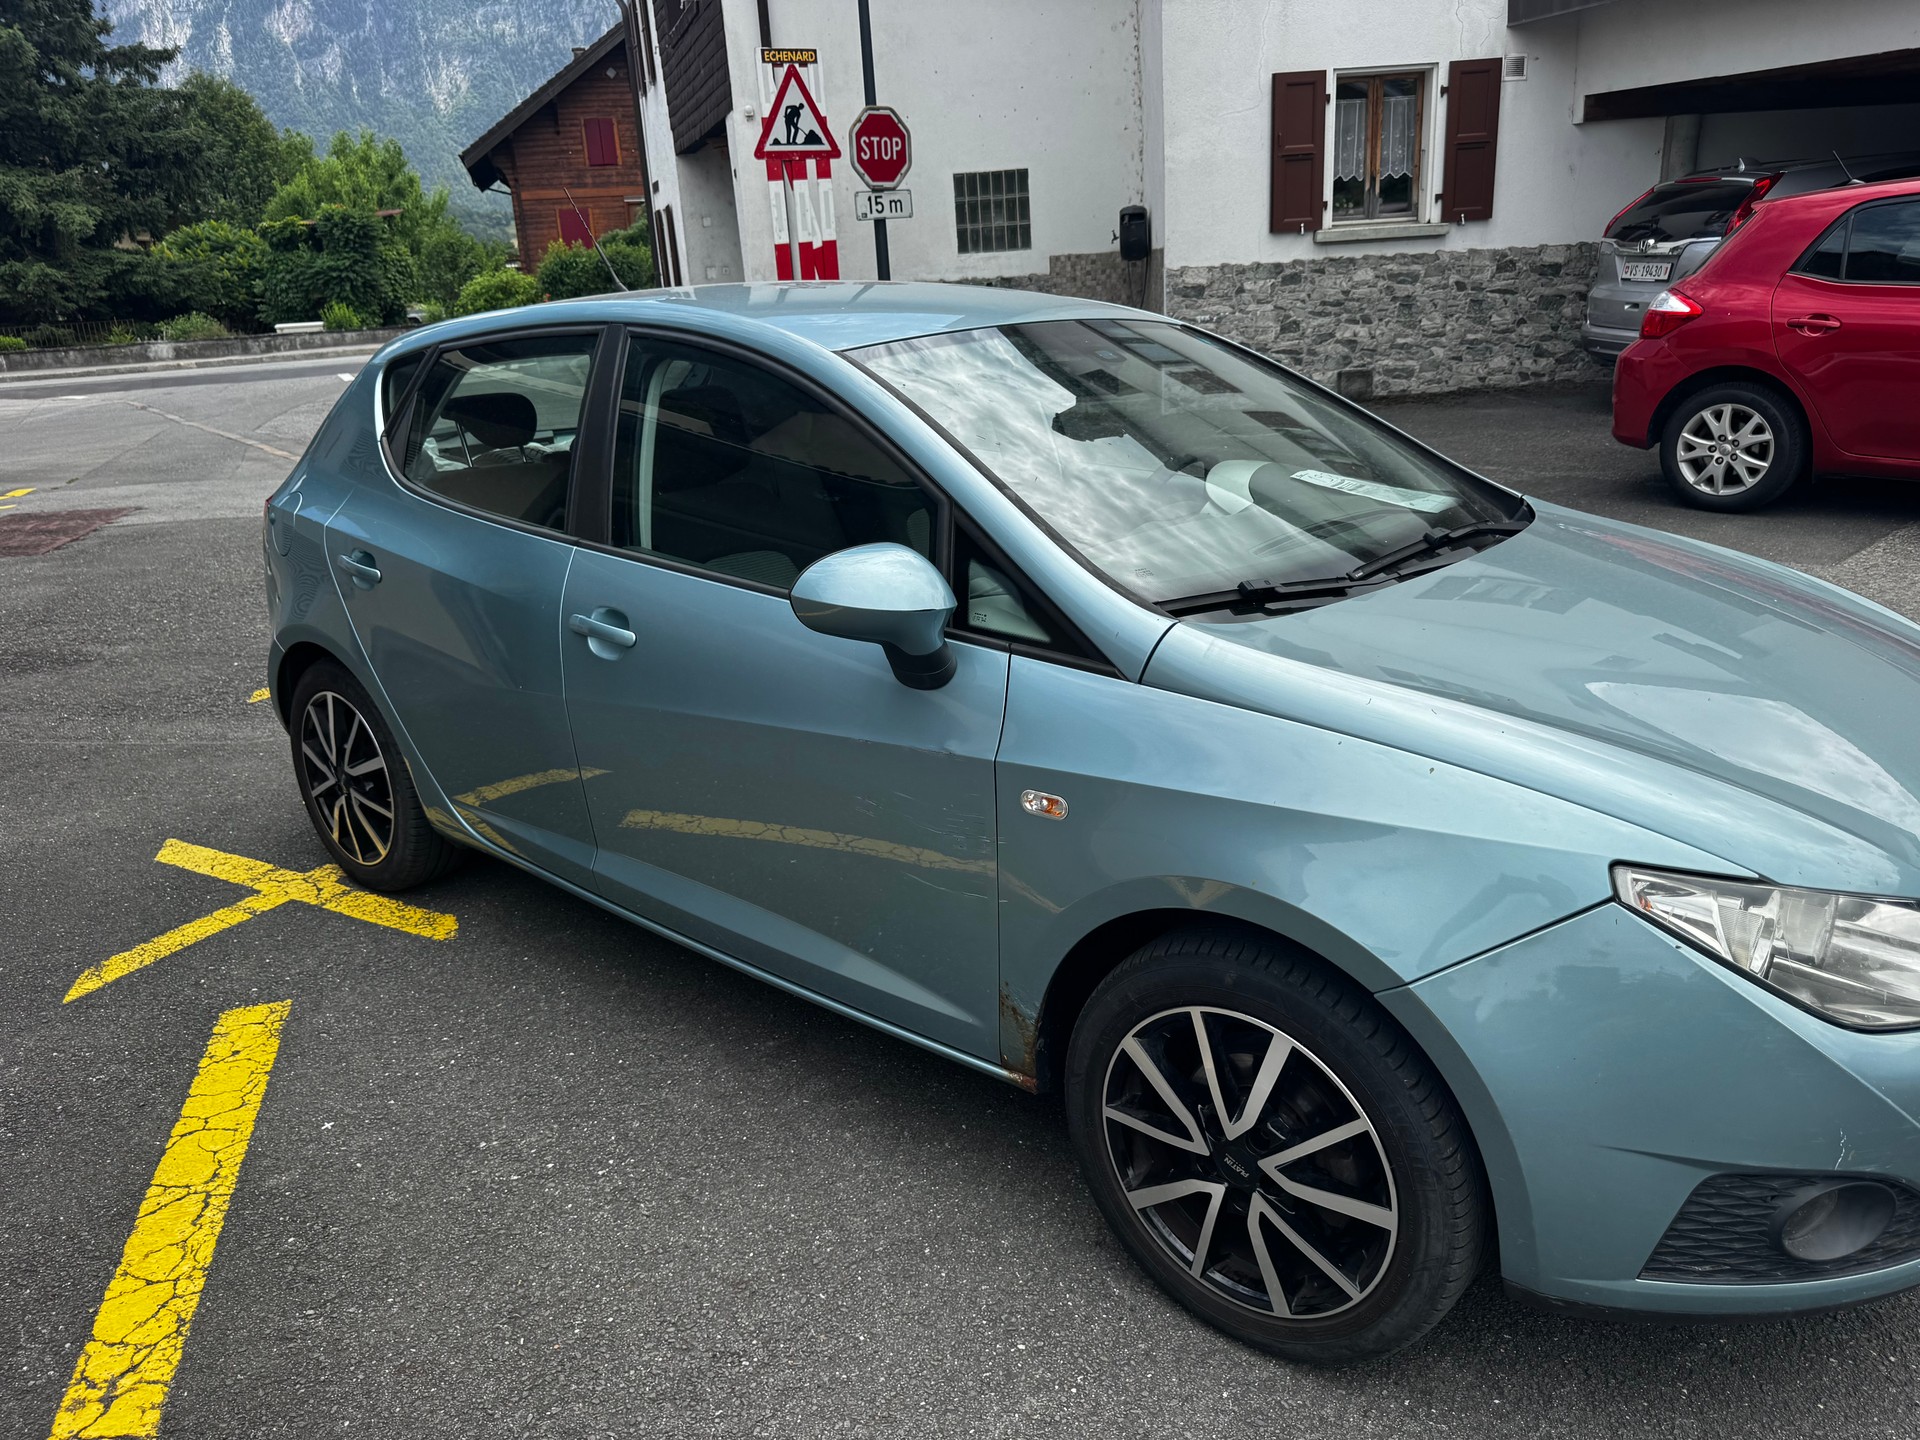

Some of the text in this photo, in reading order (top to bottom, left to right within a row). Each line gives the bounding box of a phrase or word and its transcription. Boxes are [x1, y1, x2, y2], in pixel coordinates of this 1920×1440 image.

[764, 50, 816, 62] ECHENARD
[860, 136, 902, 160] STOP
[867, 195, 903, 214] 15 m
[1223, 1157, 1250, 1178] PLATIN
